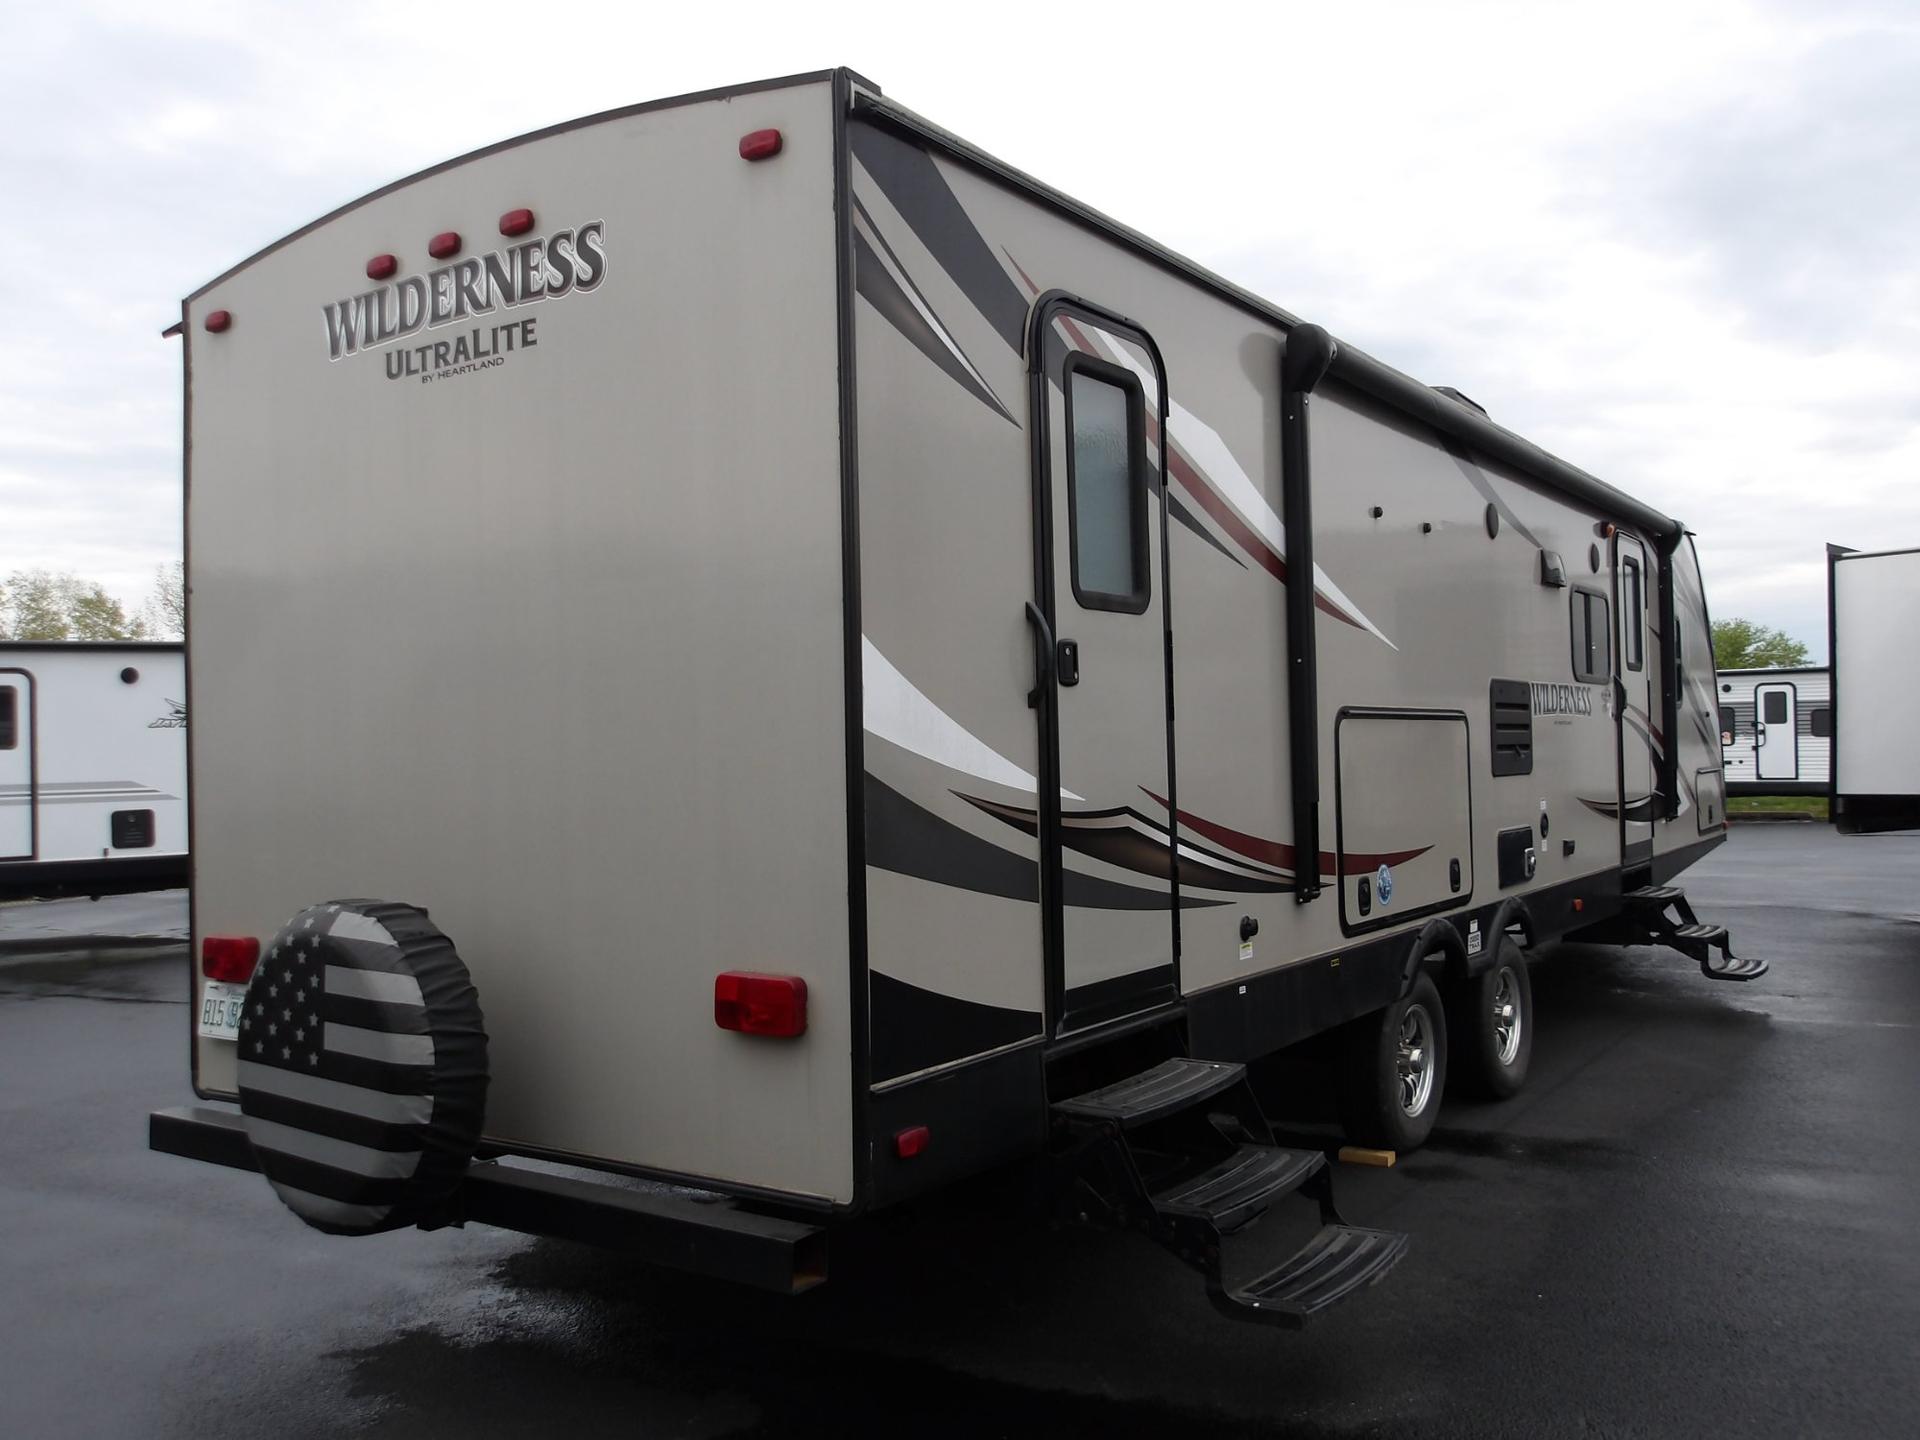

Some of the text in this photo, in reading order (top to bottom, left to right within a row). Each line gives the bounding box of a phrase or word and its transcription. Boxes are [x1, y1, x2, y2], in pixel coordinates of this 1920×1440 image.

[321, 218, 608, 362] WILDERNESS
[385, 318, 538, 381] ULTRALITE
[421, 357, 505, 384] BY HEARTLAND
[1531, 682, 1592, 716] WILDERNESS
